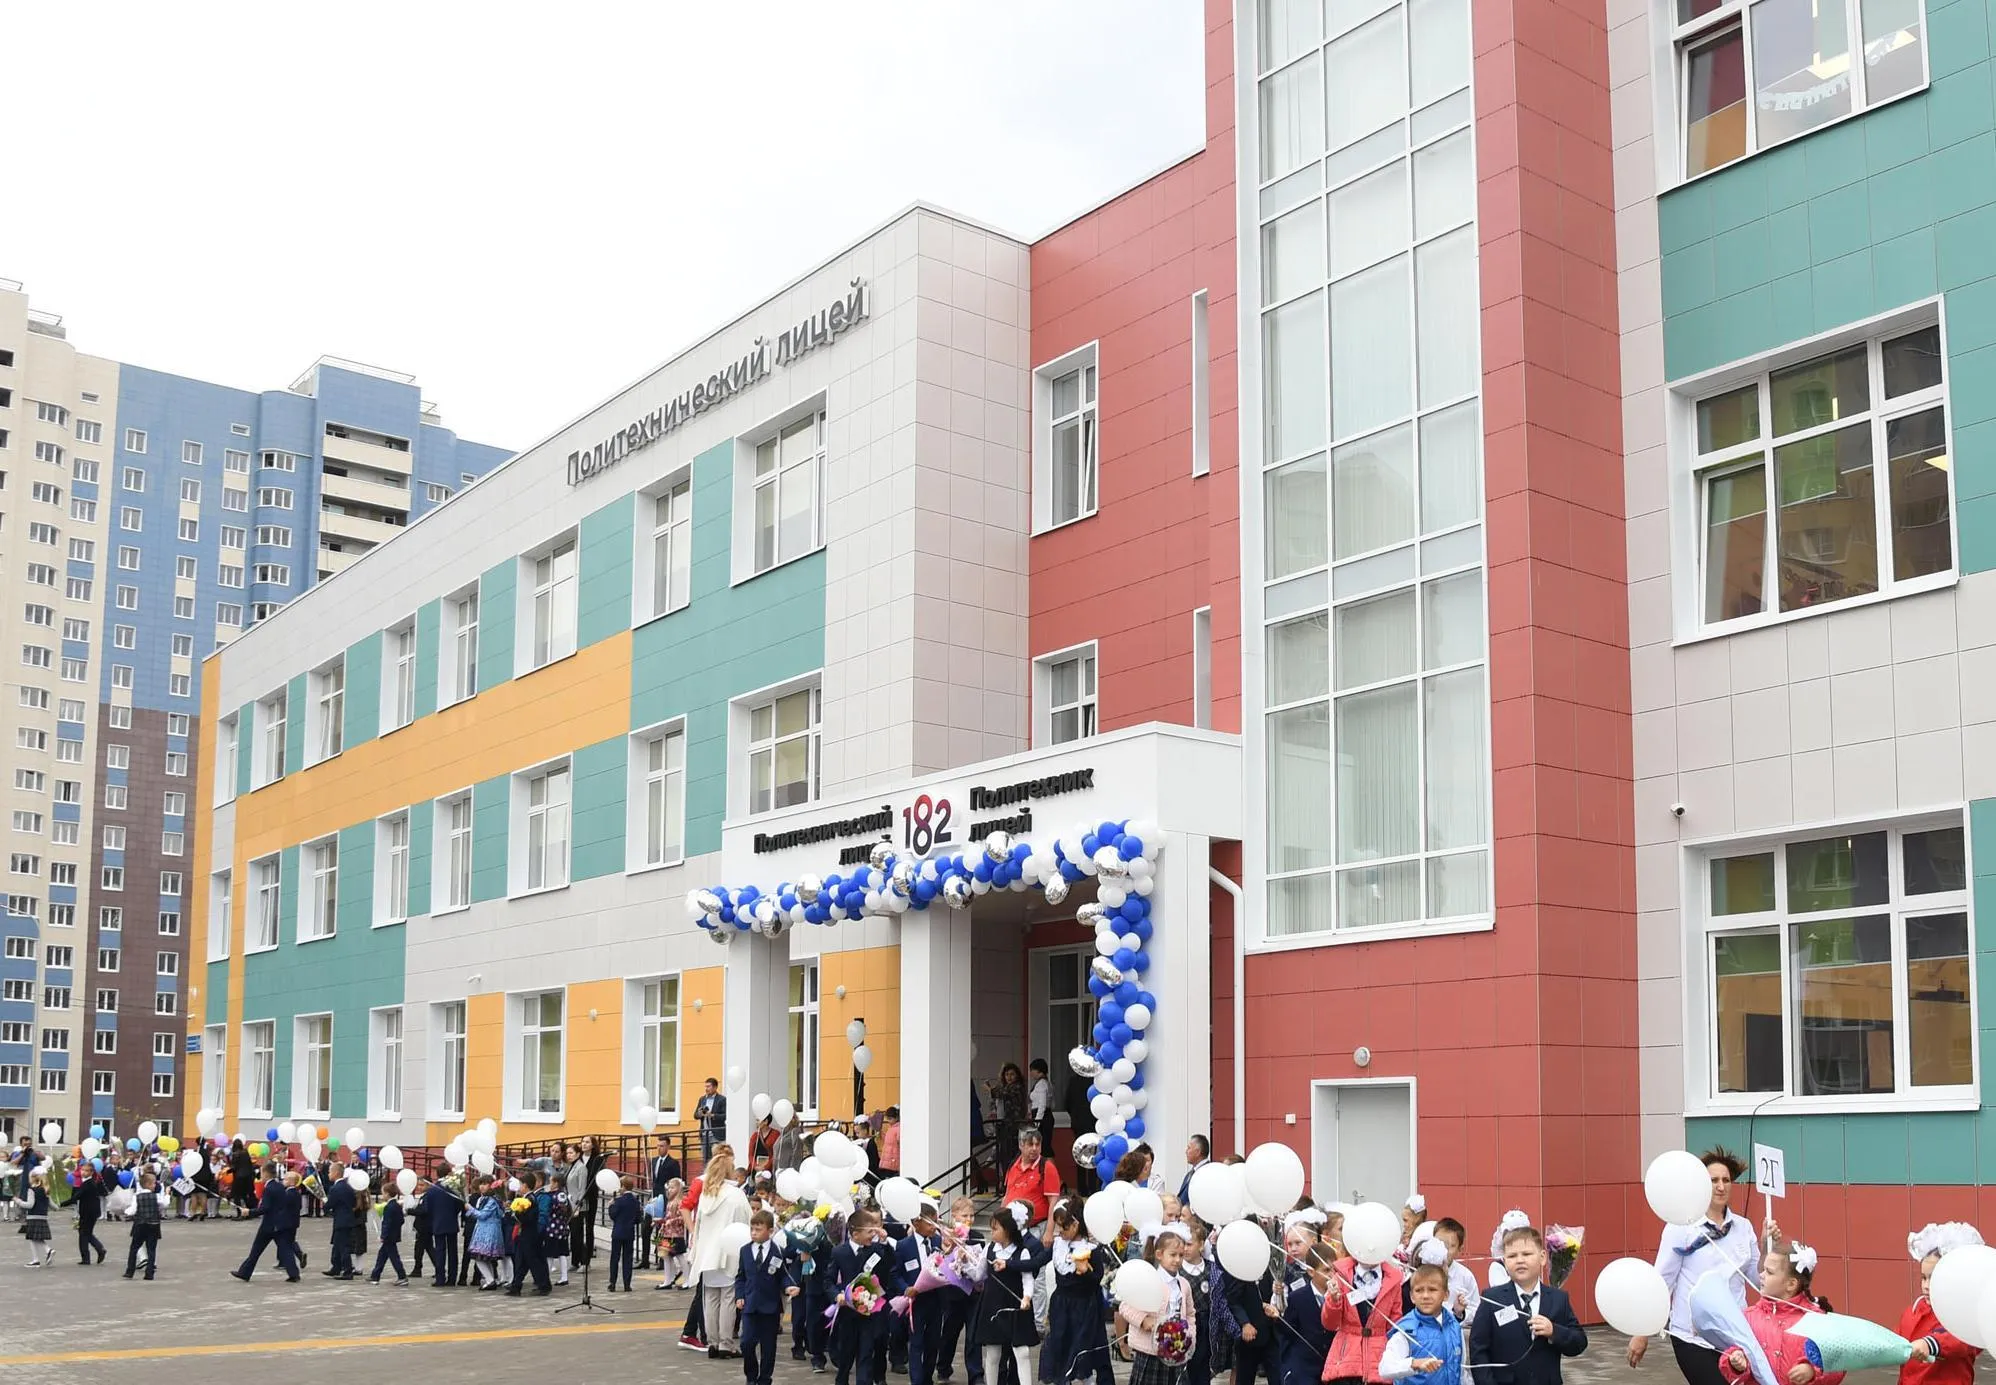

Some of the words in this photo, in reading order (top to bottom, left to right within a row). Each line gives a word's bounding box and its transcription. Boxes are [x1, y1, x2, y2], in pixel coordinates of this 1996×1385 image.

[567, 335, 771, 486] Политехнический
[775, 276, 870, 368] лицей
[970, 768, 1094, 811] Политехник
[754, 804, 893, 854] Политехнический
[838, 834, 893, 866] лиц
[903, 794, 952, 856] 182
